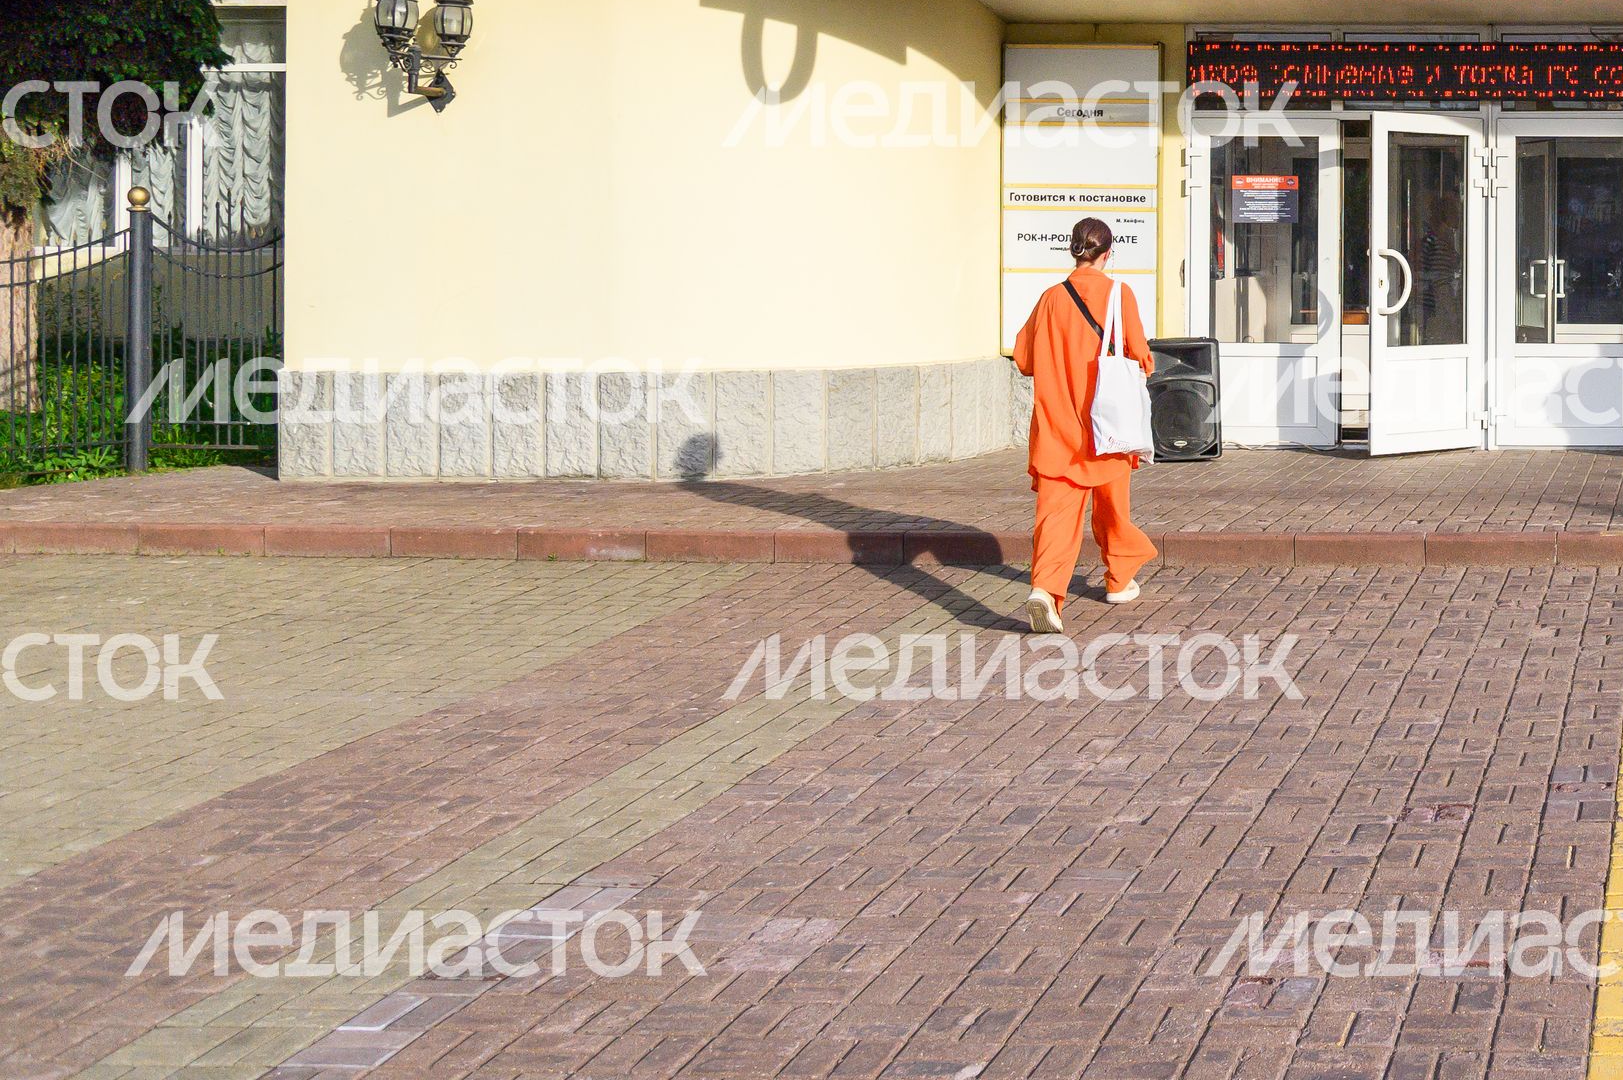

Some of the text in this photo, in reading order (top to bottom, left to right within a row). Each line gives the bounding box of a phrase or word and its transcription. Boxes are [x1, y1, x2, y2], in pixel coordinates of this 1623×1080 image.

[1057, 107, 1104, 118] Сегодня
[1009, 192, 1146, 203] Готовится к постановке
[1017, 233, 1138, 244] РОК-Н-РОЛ КАТЕ
